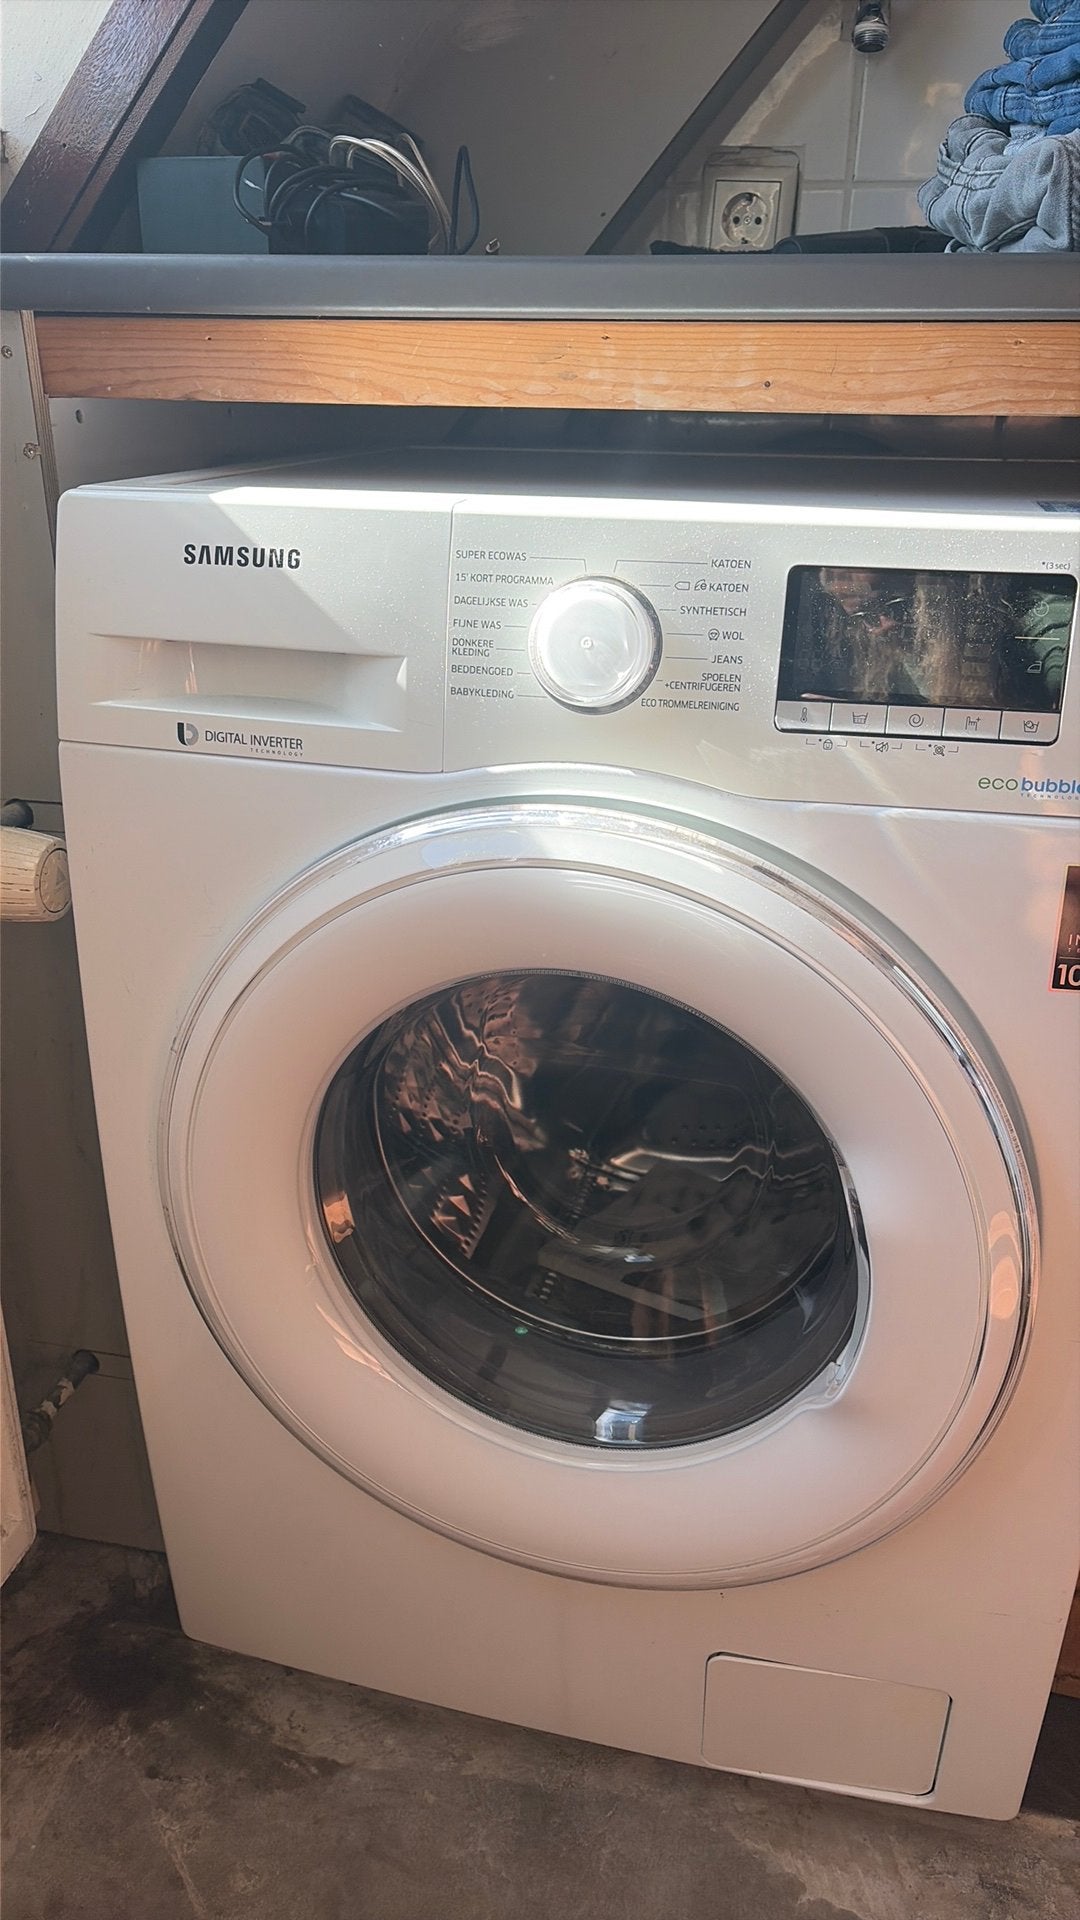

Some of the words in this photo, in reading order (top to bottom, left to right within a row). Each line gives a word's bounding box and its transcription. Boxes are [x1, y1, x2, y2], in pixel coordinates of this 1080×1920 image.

[183, 543, 301, 570] SAMSUNG
[455, 549, 486, 560] SUPER
[488, 550, 527, 562] ECOWAS
[711, 558, 752, 569] KATOEN
[470, 573, 494, 584] KORT
[495, 575, 554, 586] PROGRAMMA
[708, 582, 749, 593] KATOEN
[454, 595, 507, 608] DAGELIJKSE
[508, 598, 529, 608] WAS
[680, 605, 747, 617] SYNTHETISCH
[453, 618, 479, 629] FIJNE
[480, 620, 502, 630] WAS
[722, 631, 744, 641] WOL
[452, 637, 494, 649] DONKERE
[451, 647, 490, 658] KLEDING
[711, 654, 743, 665] JEANS
[451, 664, 514, 677] BEDDENGOED
[701, 672, 742, 683] SPOELEN
[450, 686, 515, 699] BABYKLEDING
[664, 680, 741, 693] +CENTRIFUGEREN
[640, 698, 657, 708] ECO
[658, 699, 740, 712] TROMMELREINIGING
[205, 730, 247, 745] DIGITAL
[250, 734, 303, 750] INVERTER
[250, 747, 303, 757] TECHNOLOGY
[978, 777, 1018, 791] eco
